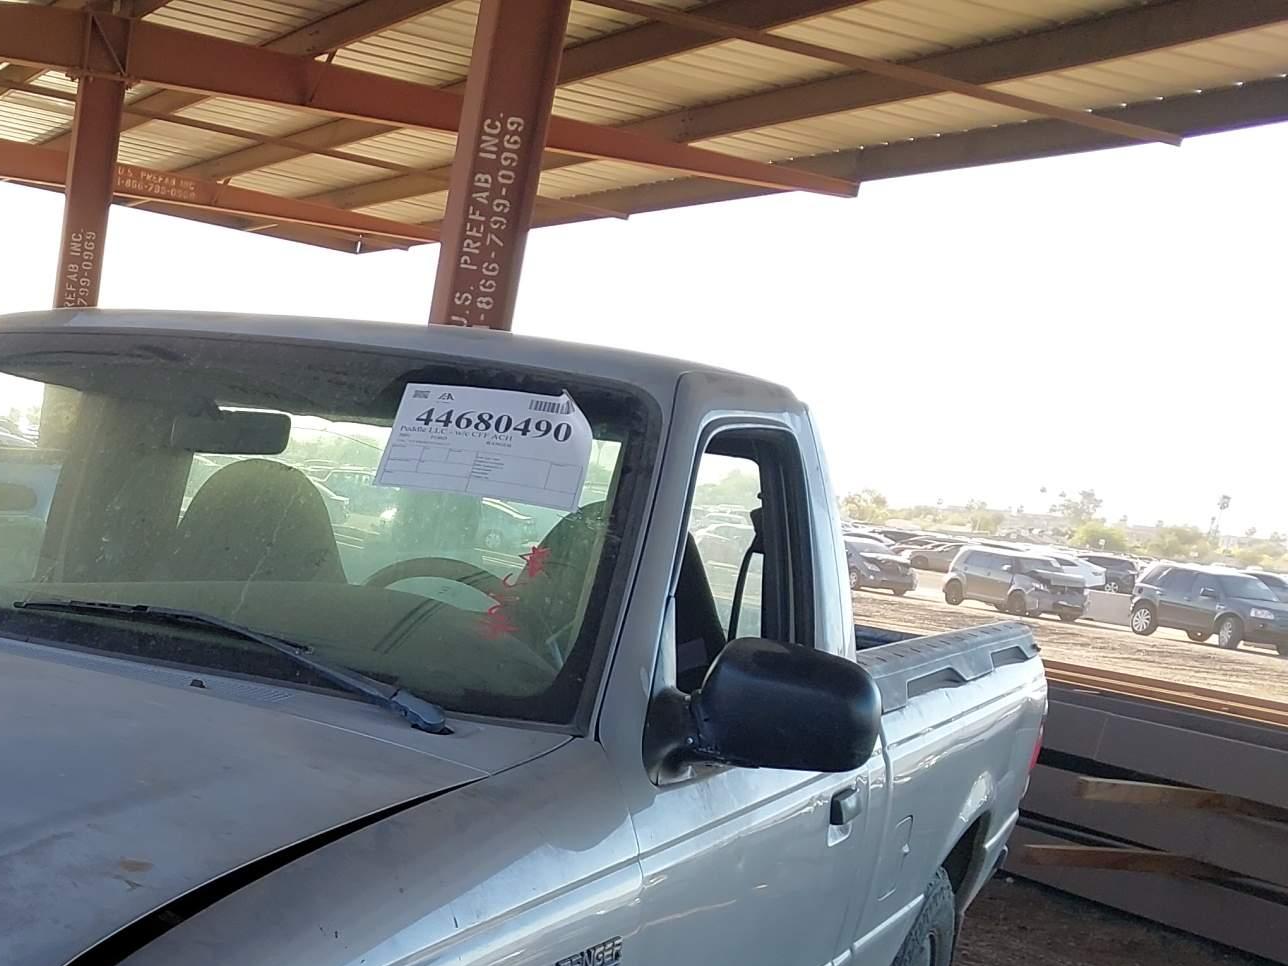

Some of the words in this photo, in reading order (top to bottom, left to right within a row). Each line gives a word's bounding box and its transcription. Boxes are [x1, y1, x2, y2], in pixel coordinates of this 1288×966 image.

[460, 173, 492, 270] PREFAB
[479, 112, 504, 160] INC.
[415, 407, 572, 442] 44680490
